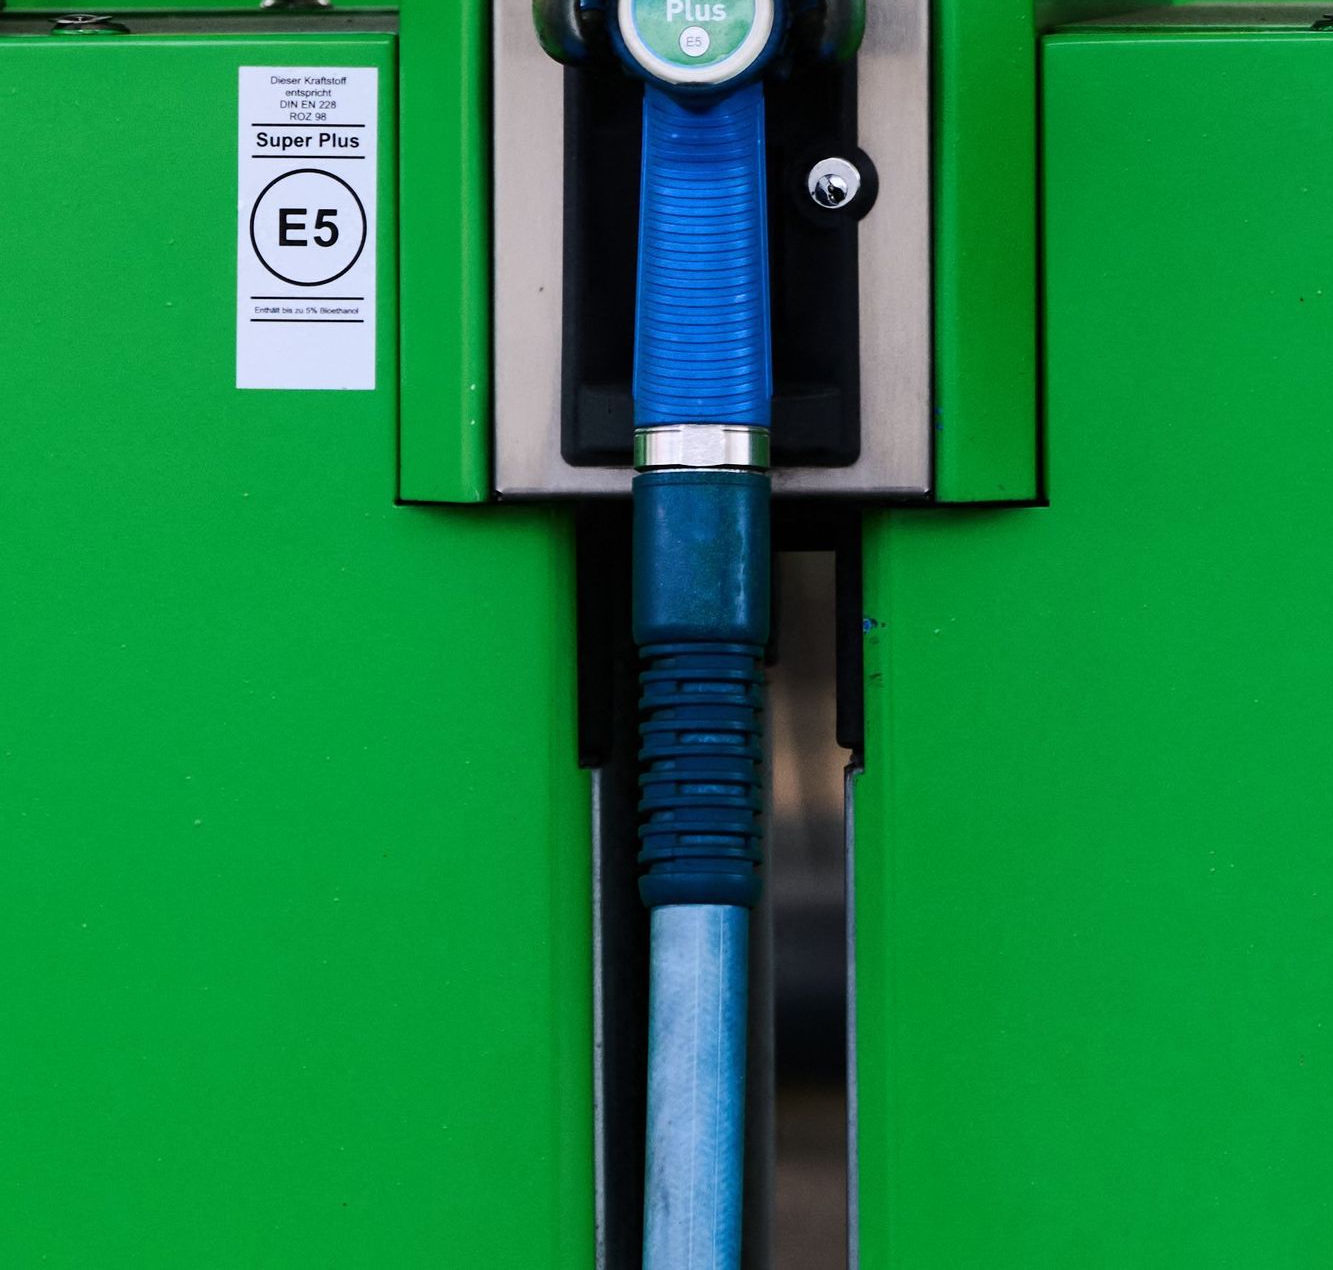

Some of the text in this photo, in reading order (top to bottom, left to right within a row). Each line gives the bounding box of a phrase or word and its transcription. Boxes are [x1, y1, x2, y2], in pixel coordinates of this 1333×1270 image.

[686, 36, 703, 47] E5
[270, 76, 347, 85] Dieser Kraftstoff
[285, 89, 332, 98] entspricht
[280, 100, 337, 109] DIN EN 228
[290, 113, 327, 121] ROZ 98
[256, 132, 360, 151] Super Plus
[279, 208, 339, 248] E5
